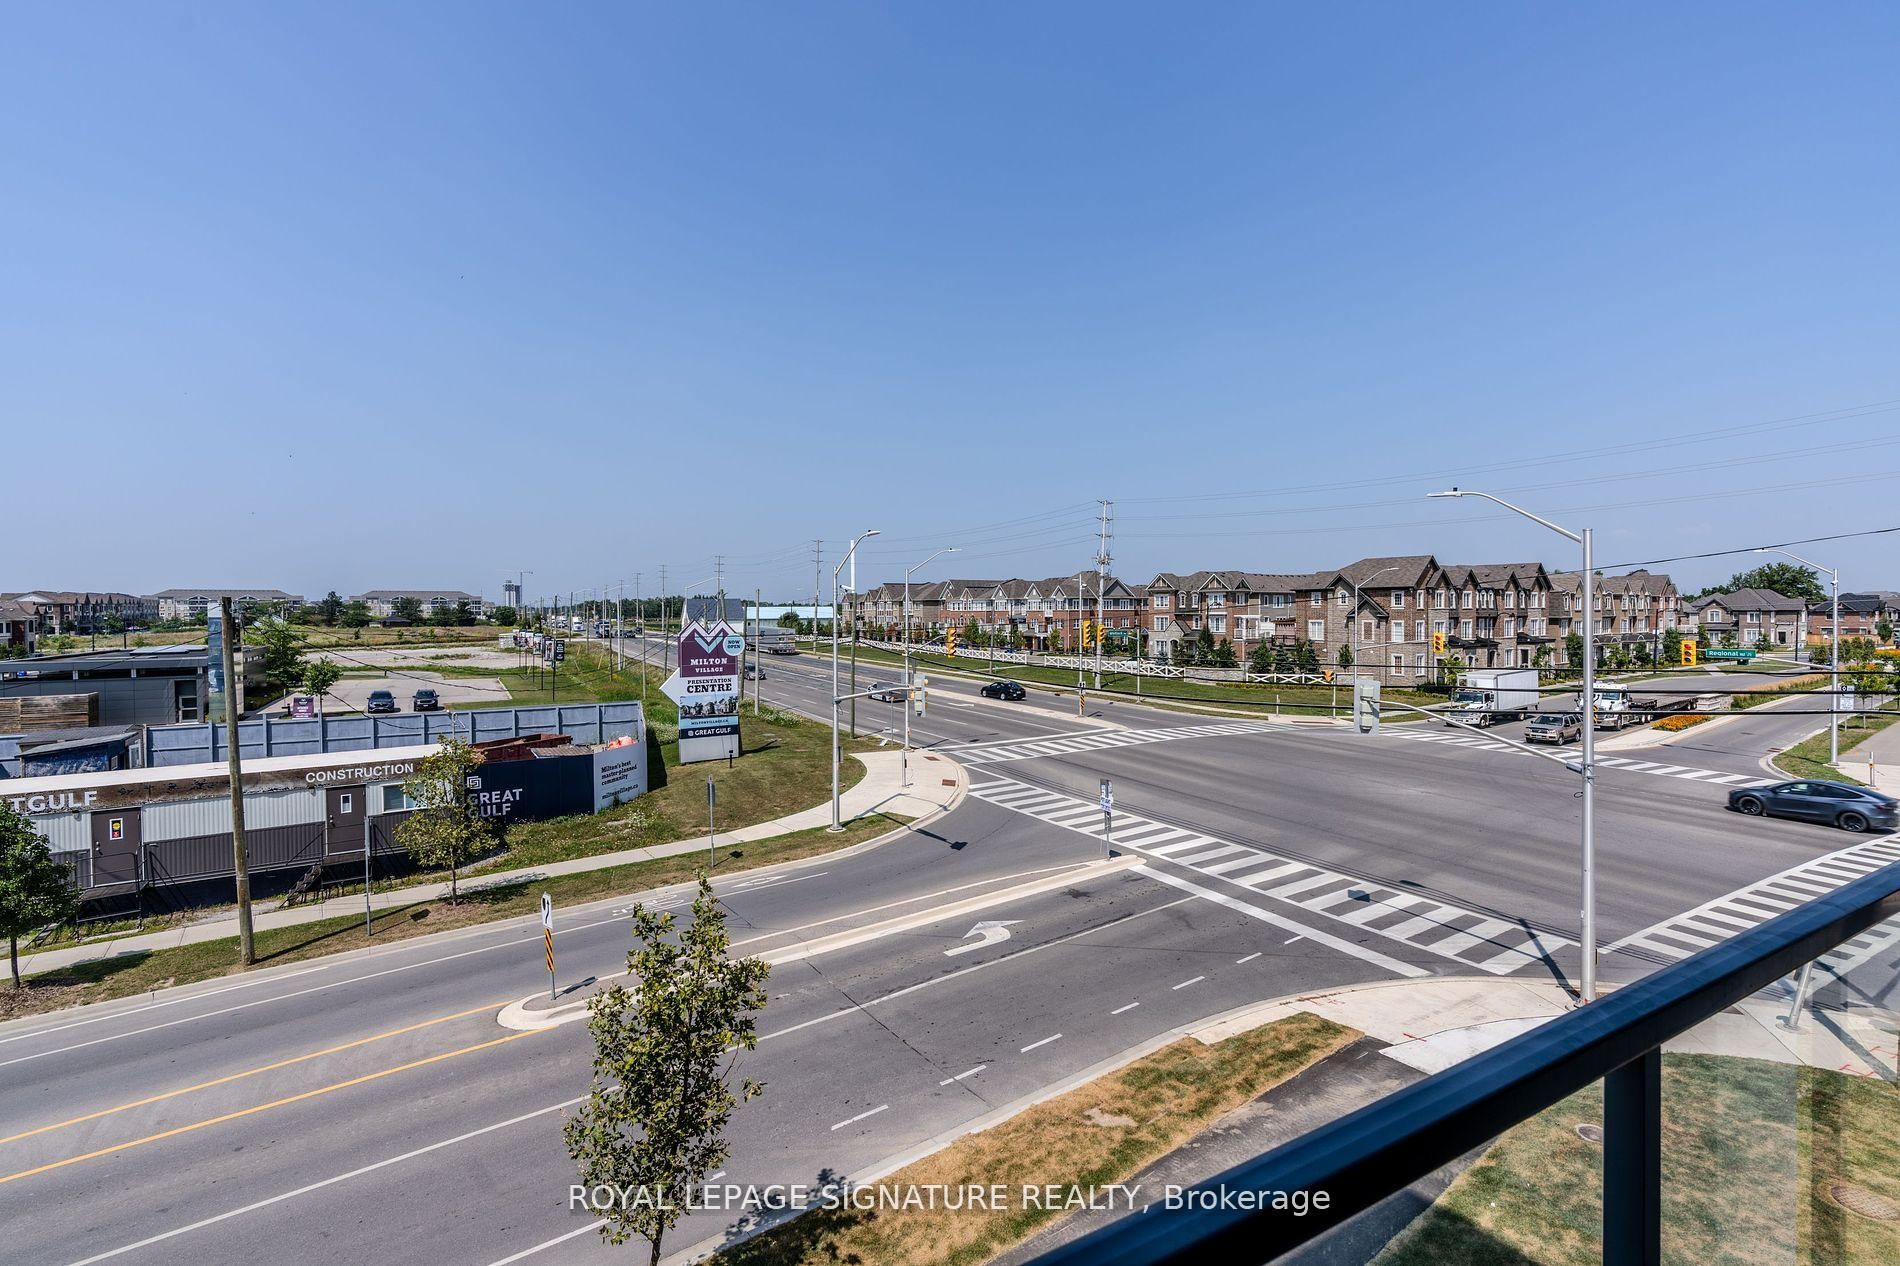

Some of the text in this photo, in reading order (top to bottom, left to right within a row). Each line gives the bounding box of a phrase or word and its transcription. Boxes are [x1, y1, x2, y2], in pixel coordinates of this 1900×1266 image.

[690, 658, 728, 666] MILTON
[686, 683, 732, 694] CENTRE
[694, 728, 715, 736] GREAT
[305, 763, 414, 783] CONSTRUCTION
[602, 774, 628, 786] community
[467, 788, 523, 805] GREAT
[467, 803, 511, 818] GULF
